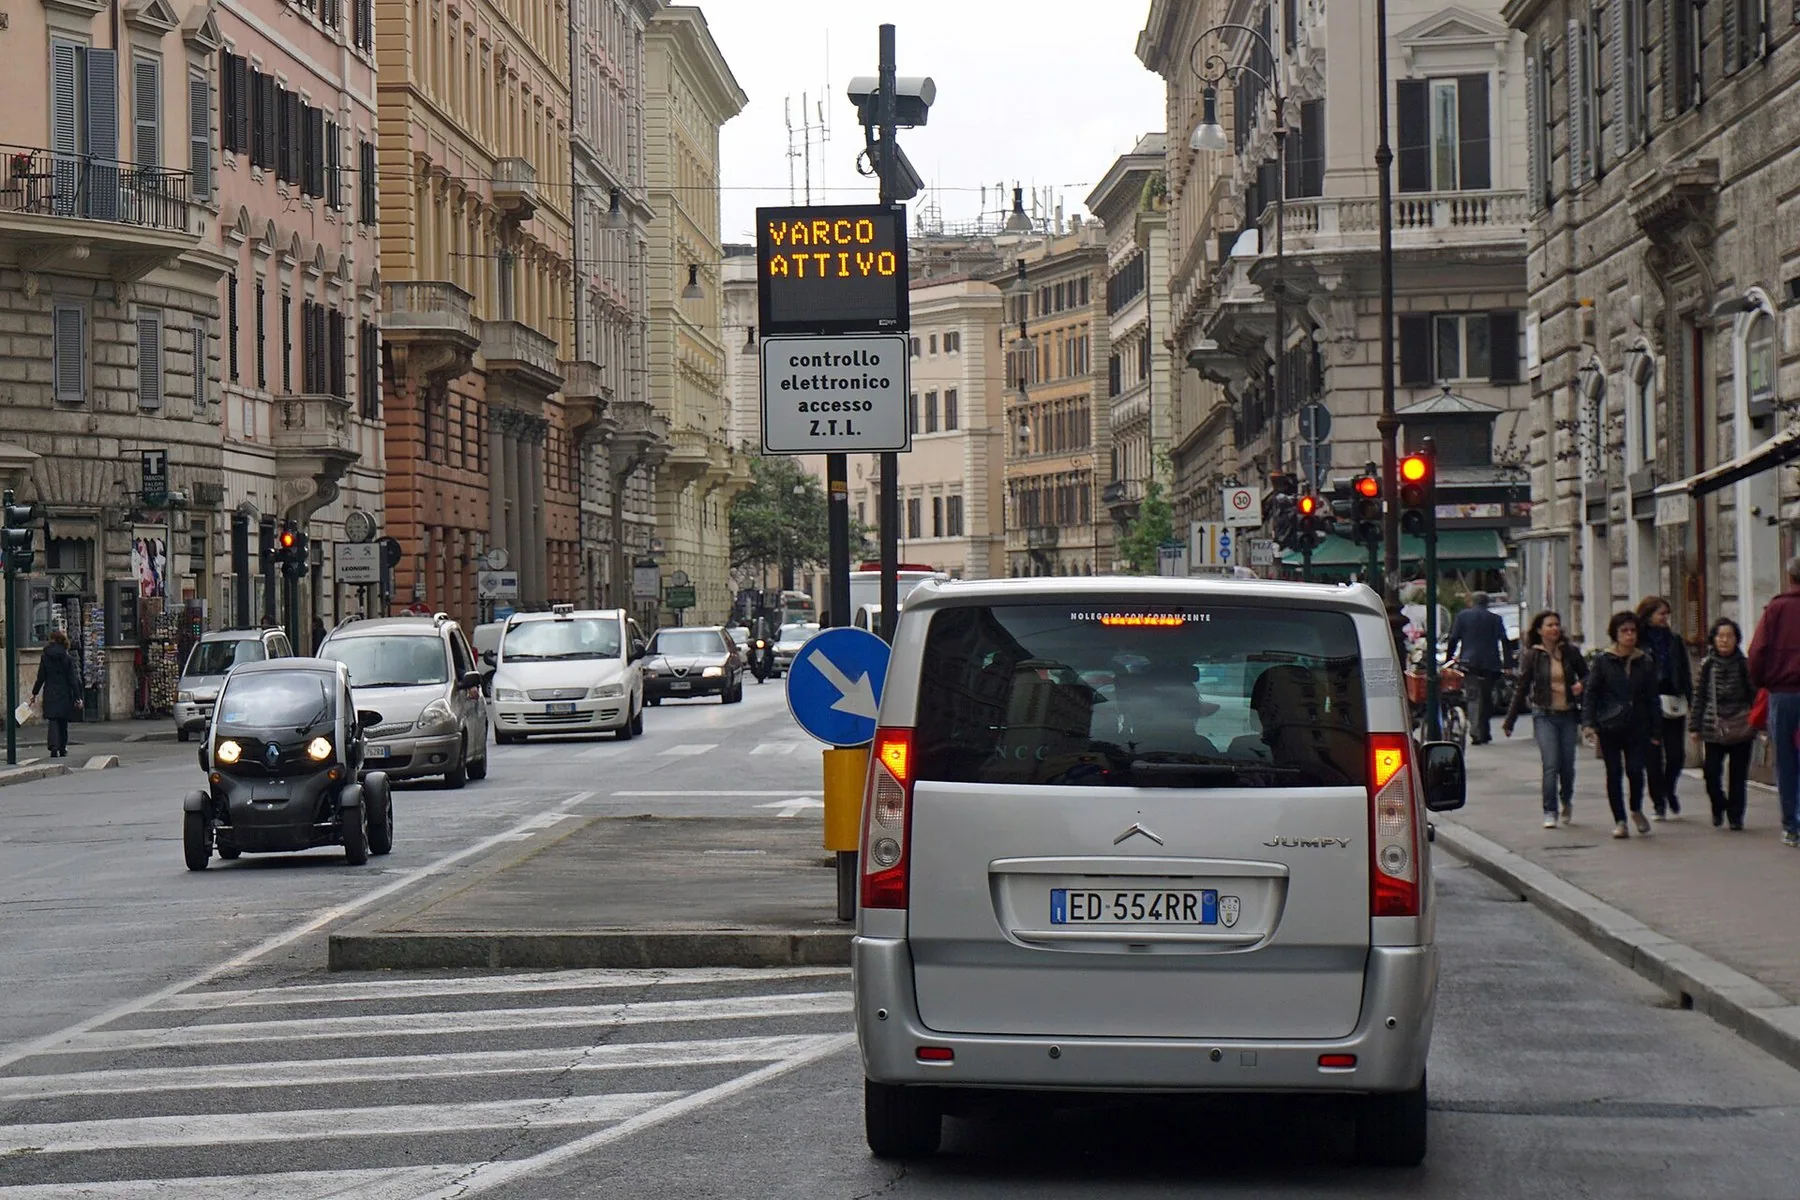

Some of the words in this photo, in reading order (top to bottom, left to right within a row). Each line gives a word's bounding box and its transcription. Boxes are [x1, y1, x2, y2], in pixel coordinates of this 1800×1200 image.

[769, 219, 874, 246] VARCO
[770, 251, 896, 278] ATTIVO
[789, 350, 880, 367] controllo
[780, 373, 890, 390] elettronico
[798, 399, 873, 413] accesso
[809, 419, 862, 436] Z.T.L.
[144, 452, 163, 475] T
[1236, 496, 1248, 506] 30
[554, 606, 573, 614] TAXI
[1070, 612, 1122, 621] NOLEGGIO
[1124, 612, 1144, 621] CON
[1147, 613, 1211, 622] CONDUCENTE
[1263, 835, 1352, 849] JUMPY
